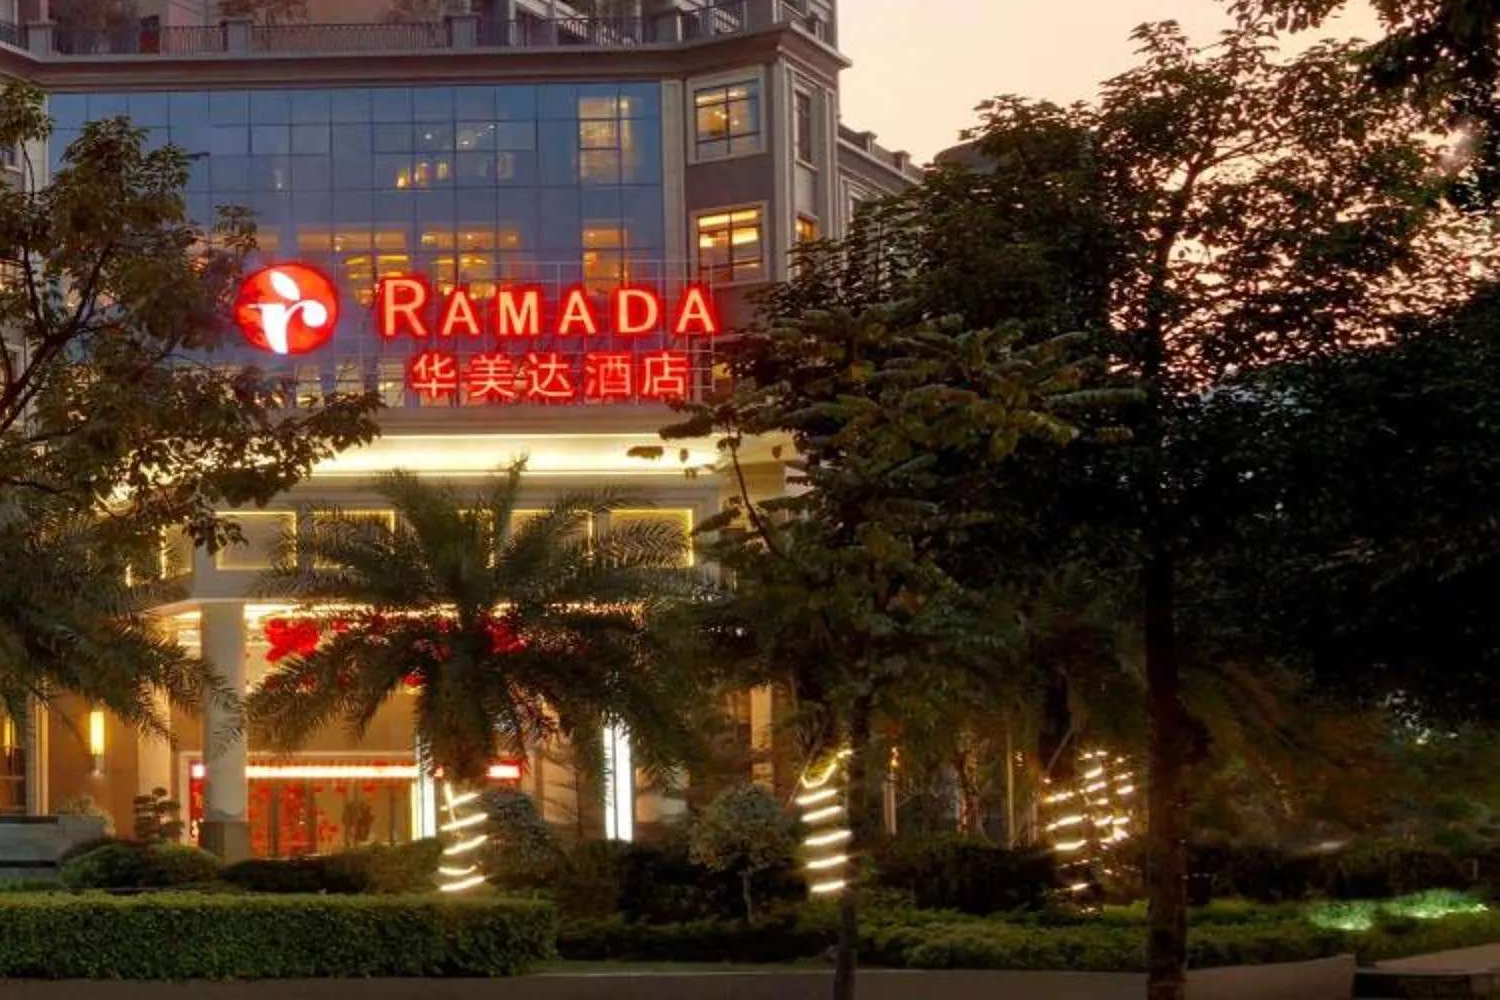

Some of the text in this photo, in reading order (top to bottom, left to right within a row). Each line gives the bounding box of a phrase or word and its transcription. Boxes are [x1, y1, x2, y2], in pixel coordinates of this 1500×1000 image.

[384, 278, 716, 336] RAMADA
[412, 353, 688, 398] 华美达酒店
